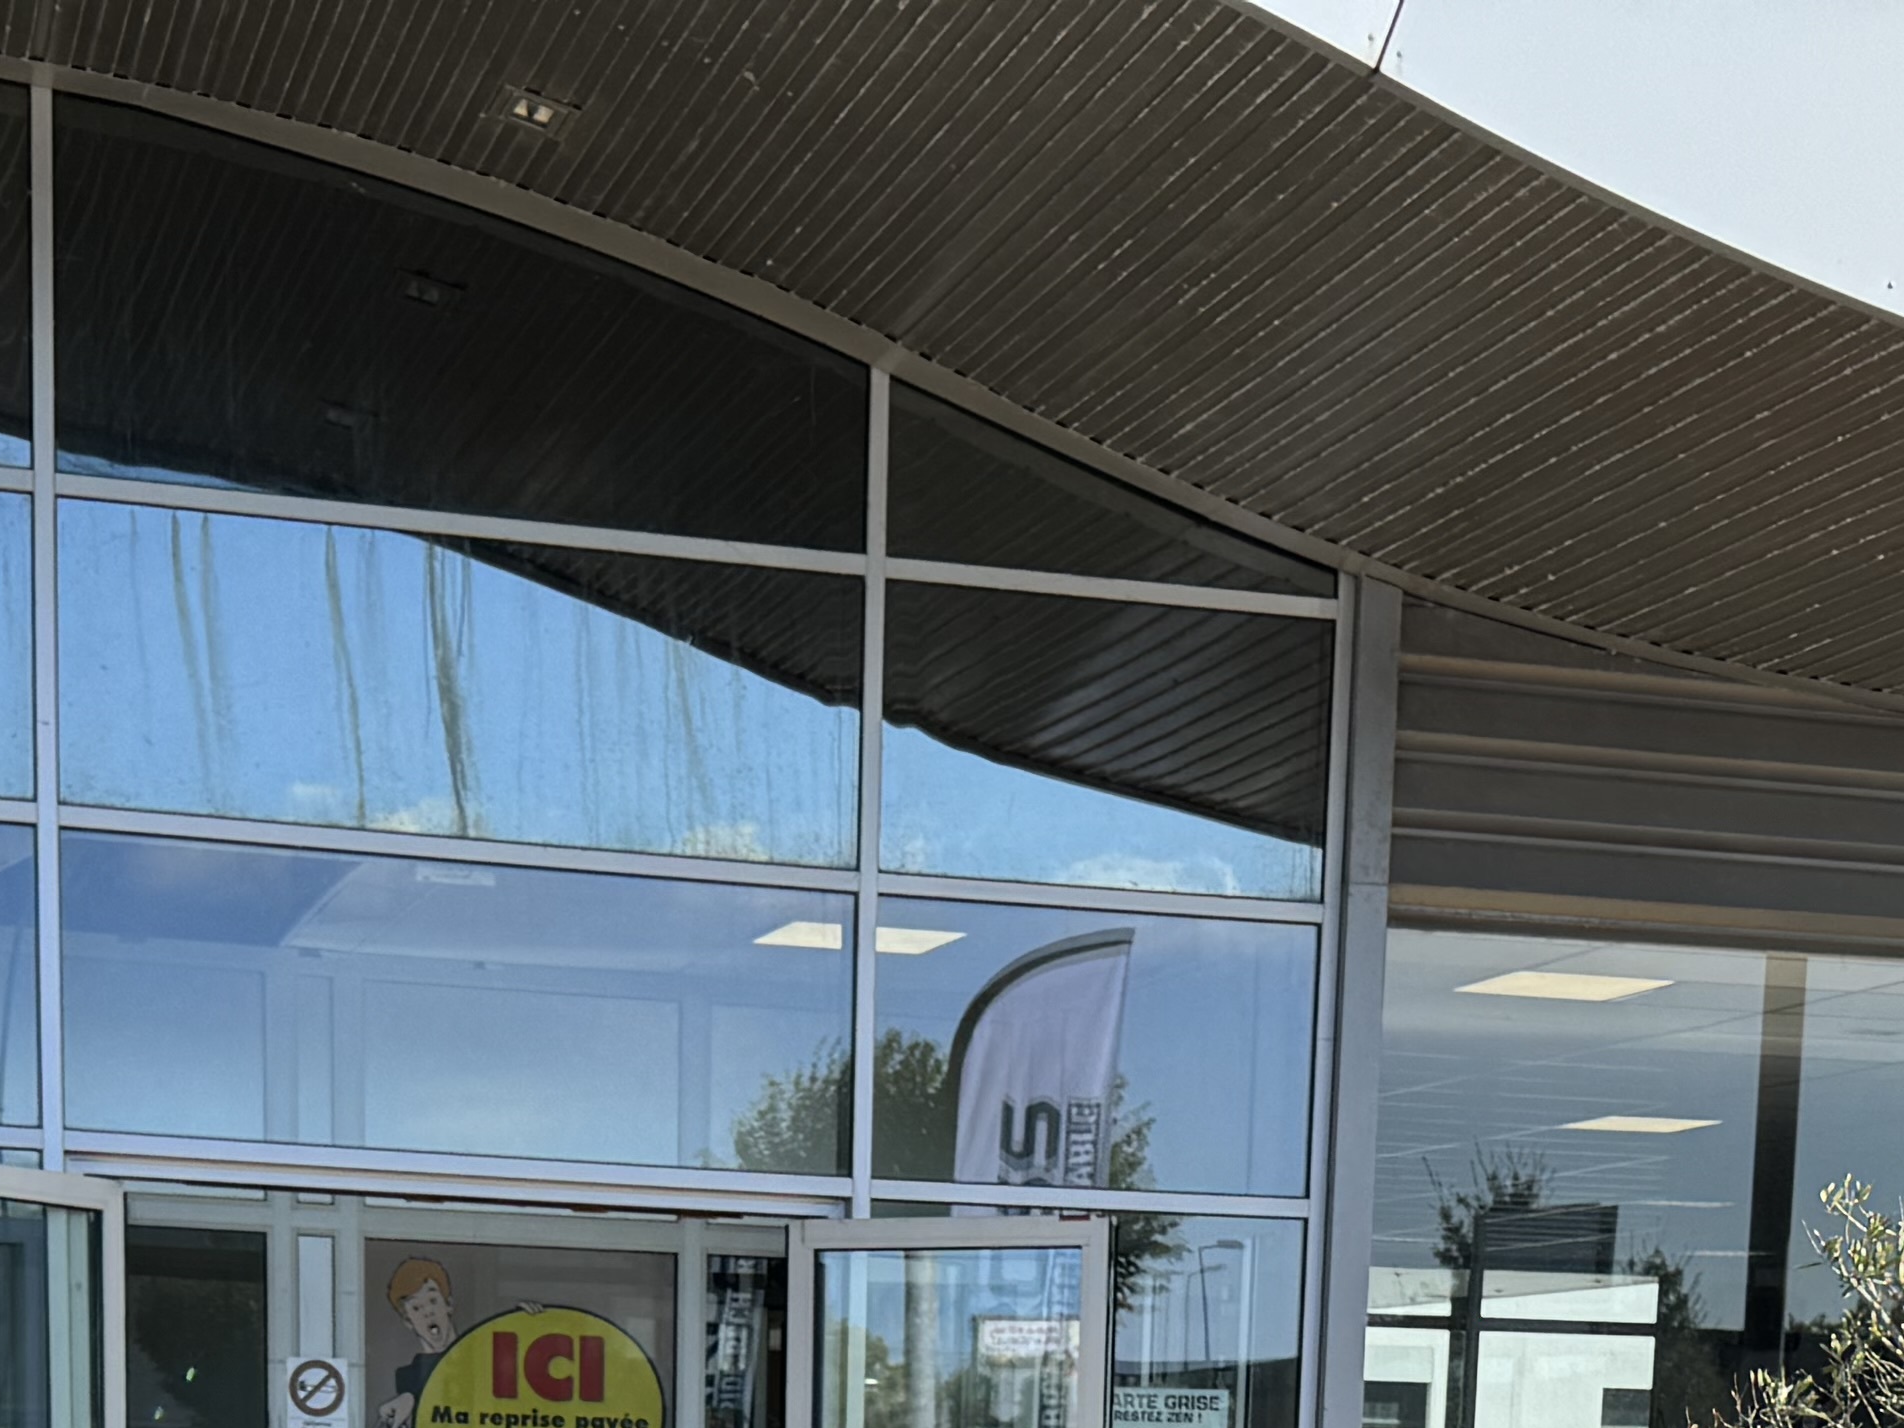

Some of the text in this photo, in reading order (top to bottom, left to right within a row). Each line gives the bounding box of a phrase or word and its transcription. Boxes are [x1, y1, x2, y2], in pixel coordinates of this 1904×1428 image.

[492, 1332, 604, 1402] ICI
[1164, 1395, 1220, 1411] GRISE
[431, 1405, 469, 1425] Ma
[1114, 1411, 1163, 1423] RESTEZ
[1167, 1412, 1194, 1423] ZEN
